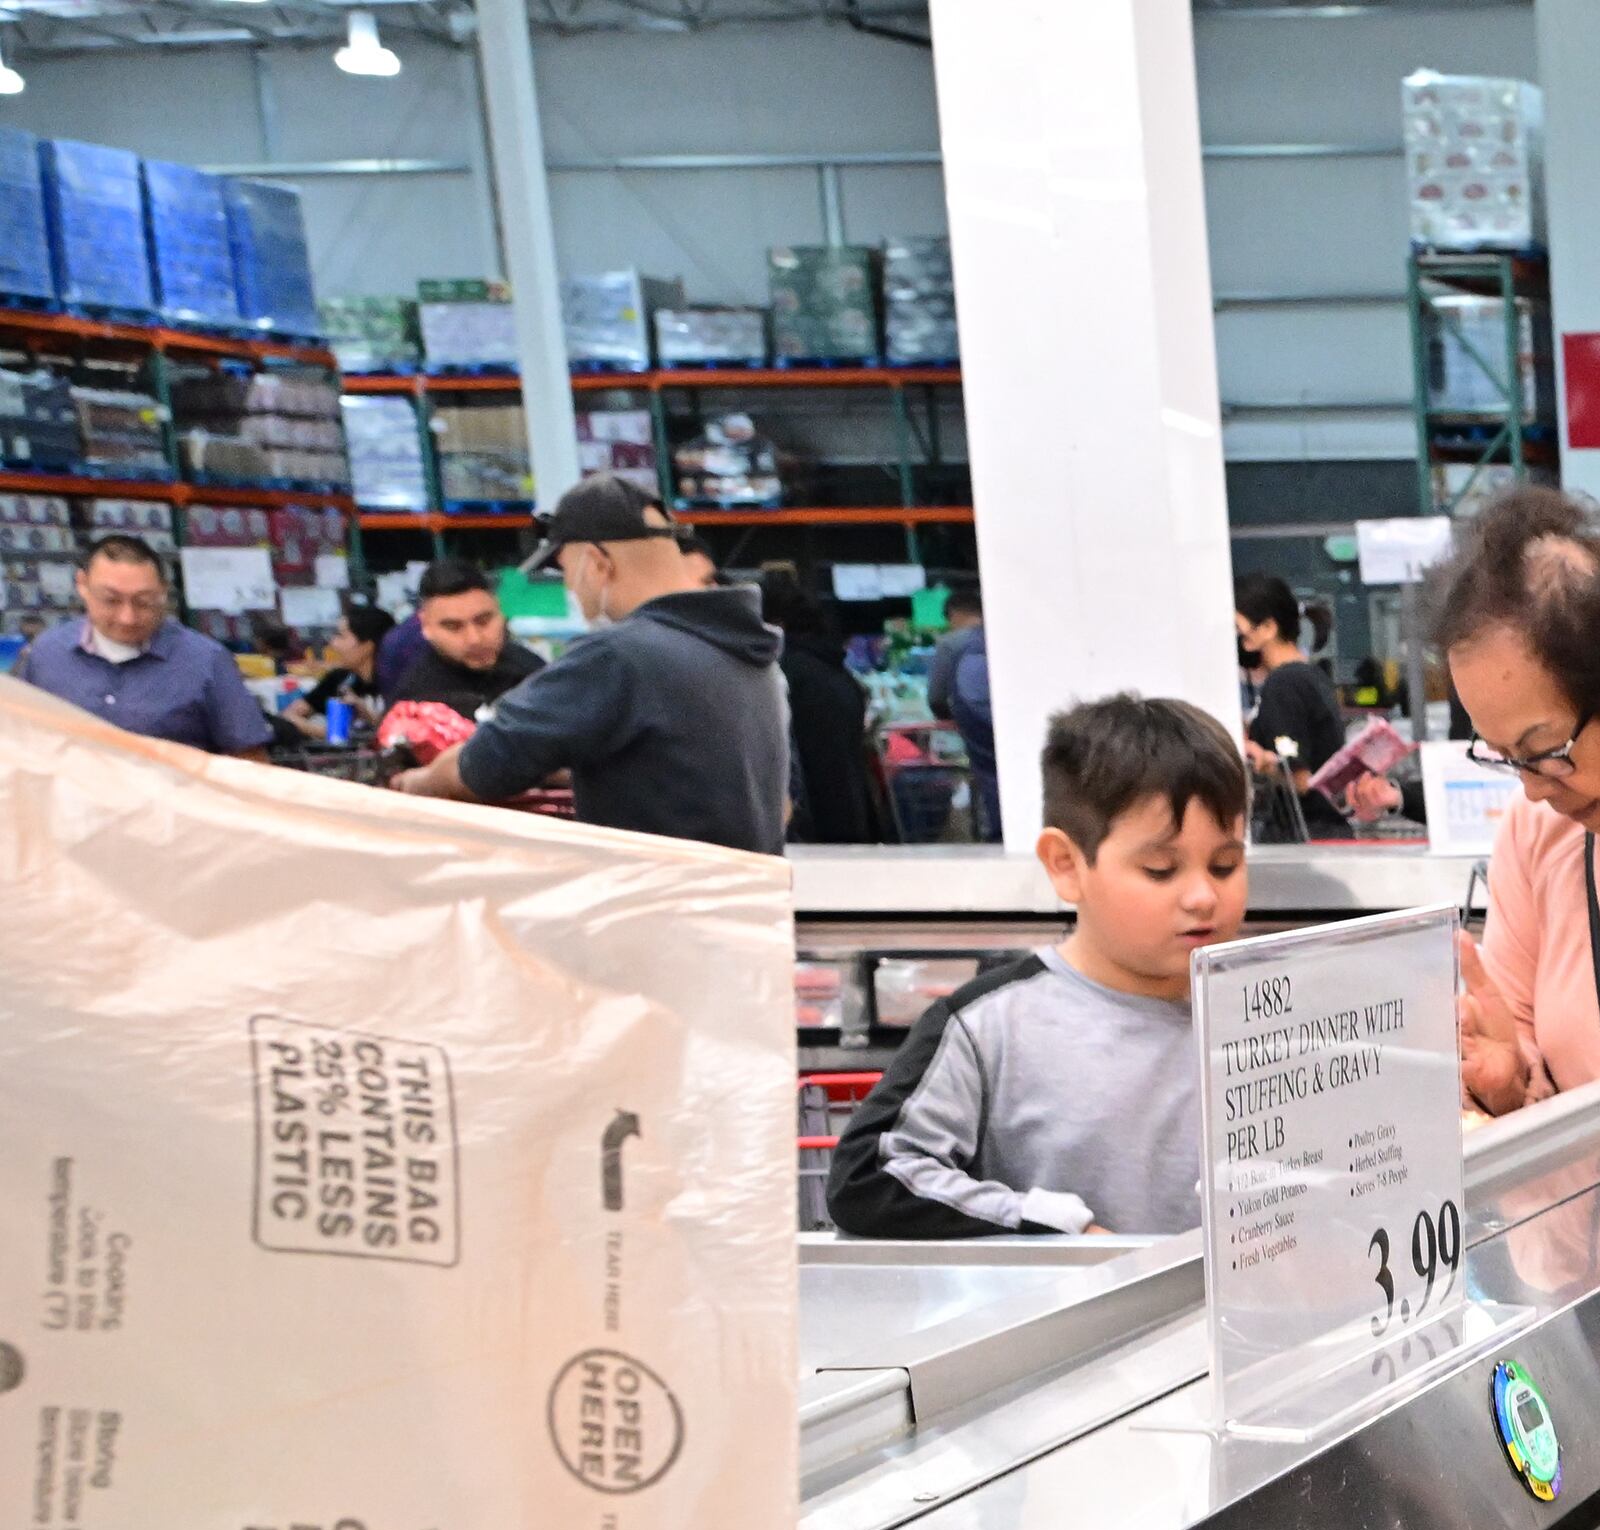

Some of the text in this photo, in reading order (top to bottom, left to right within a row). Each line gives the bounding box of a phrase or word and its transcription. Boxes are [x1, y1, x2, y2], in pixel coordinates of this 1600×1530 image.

[1222, 999, 1404, 1076] TURKEY DINNER WITH
[1242, 976, 1293, 1023] 14882
[267, 1041, 309, 1221] PLASTIC
[1225, 1044, 1383, 1121] STUFFING & GRAVY
[310, 1038, 355, 1237] 25% LESS
[353, 1041, 399, 1248] CONTAINS
[397, 1056, 440, 1243] THIS BAG
[1227, 1115, 1286, 1164] PER LB
[605, 1230, 622, 1278] TEAR
[1239, 1210, 1295, 1244] Cranberry Sauce
[1239, 1246, 1260, 1271] Fresh
[1368, 1199, 1461, 1337] 3.99
[580, 1360, 606, 1477] HERE
[613, 1366, 642, 1483] OPEN
